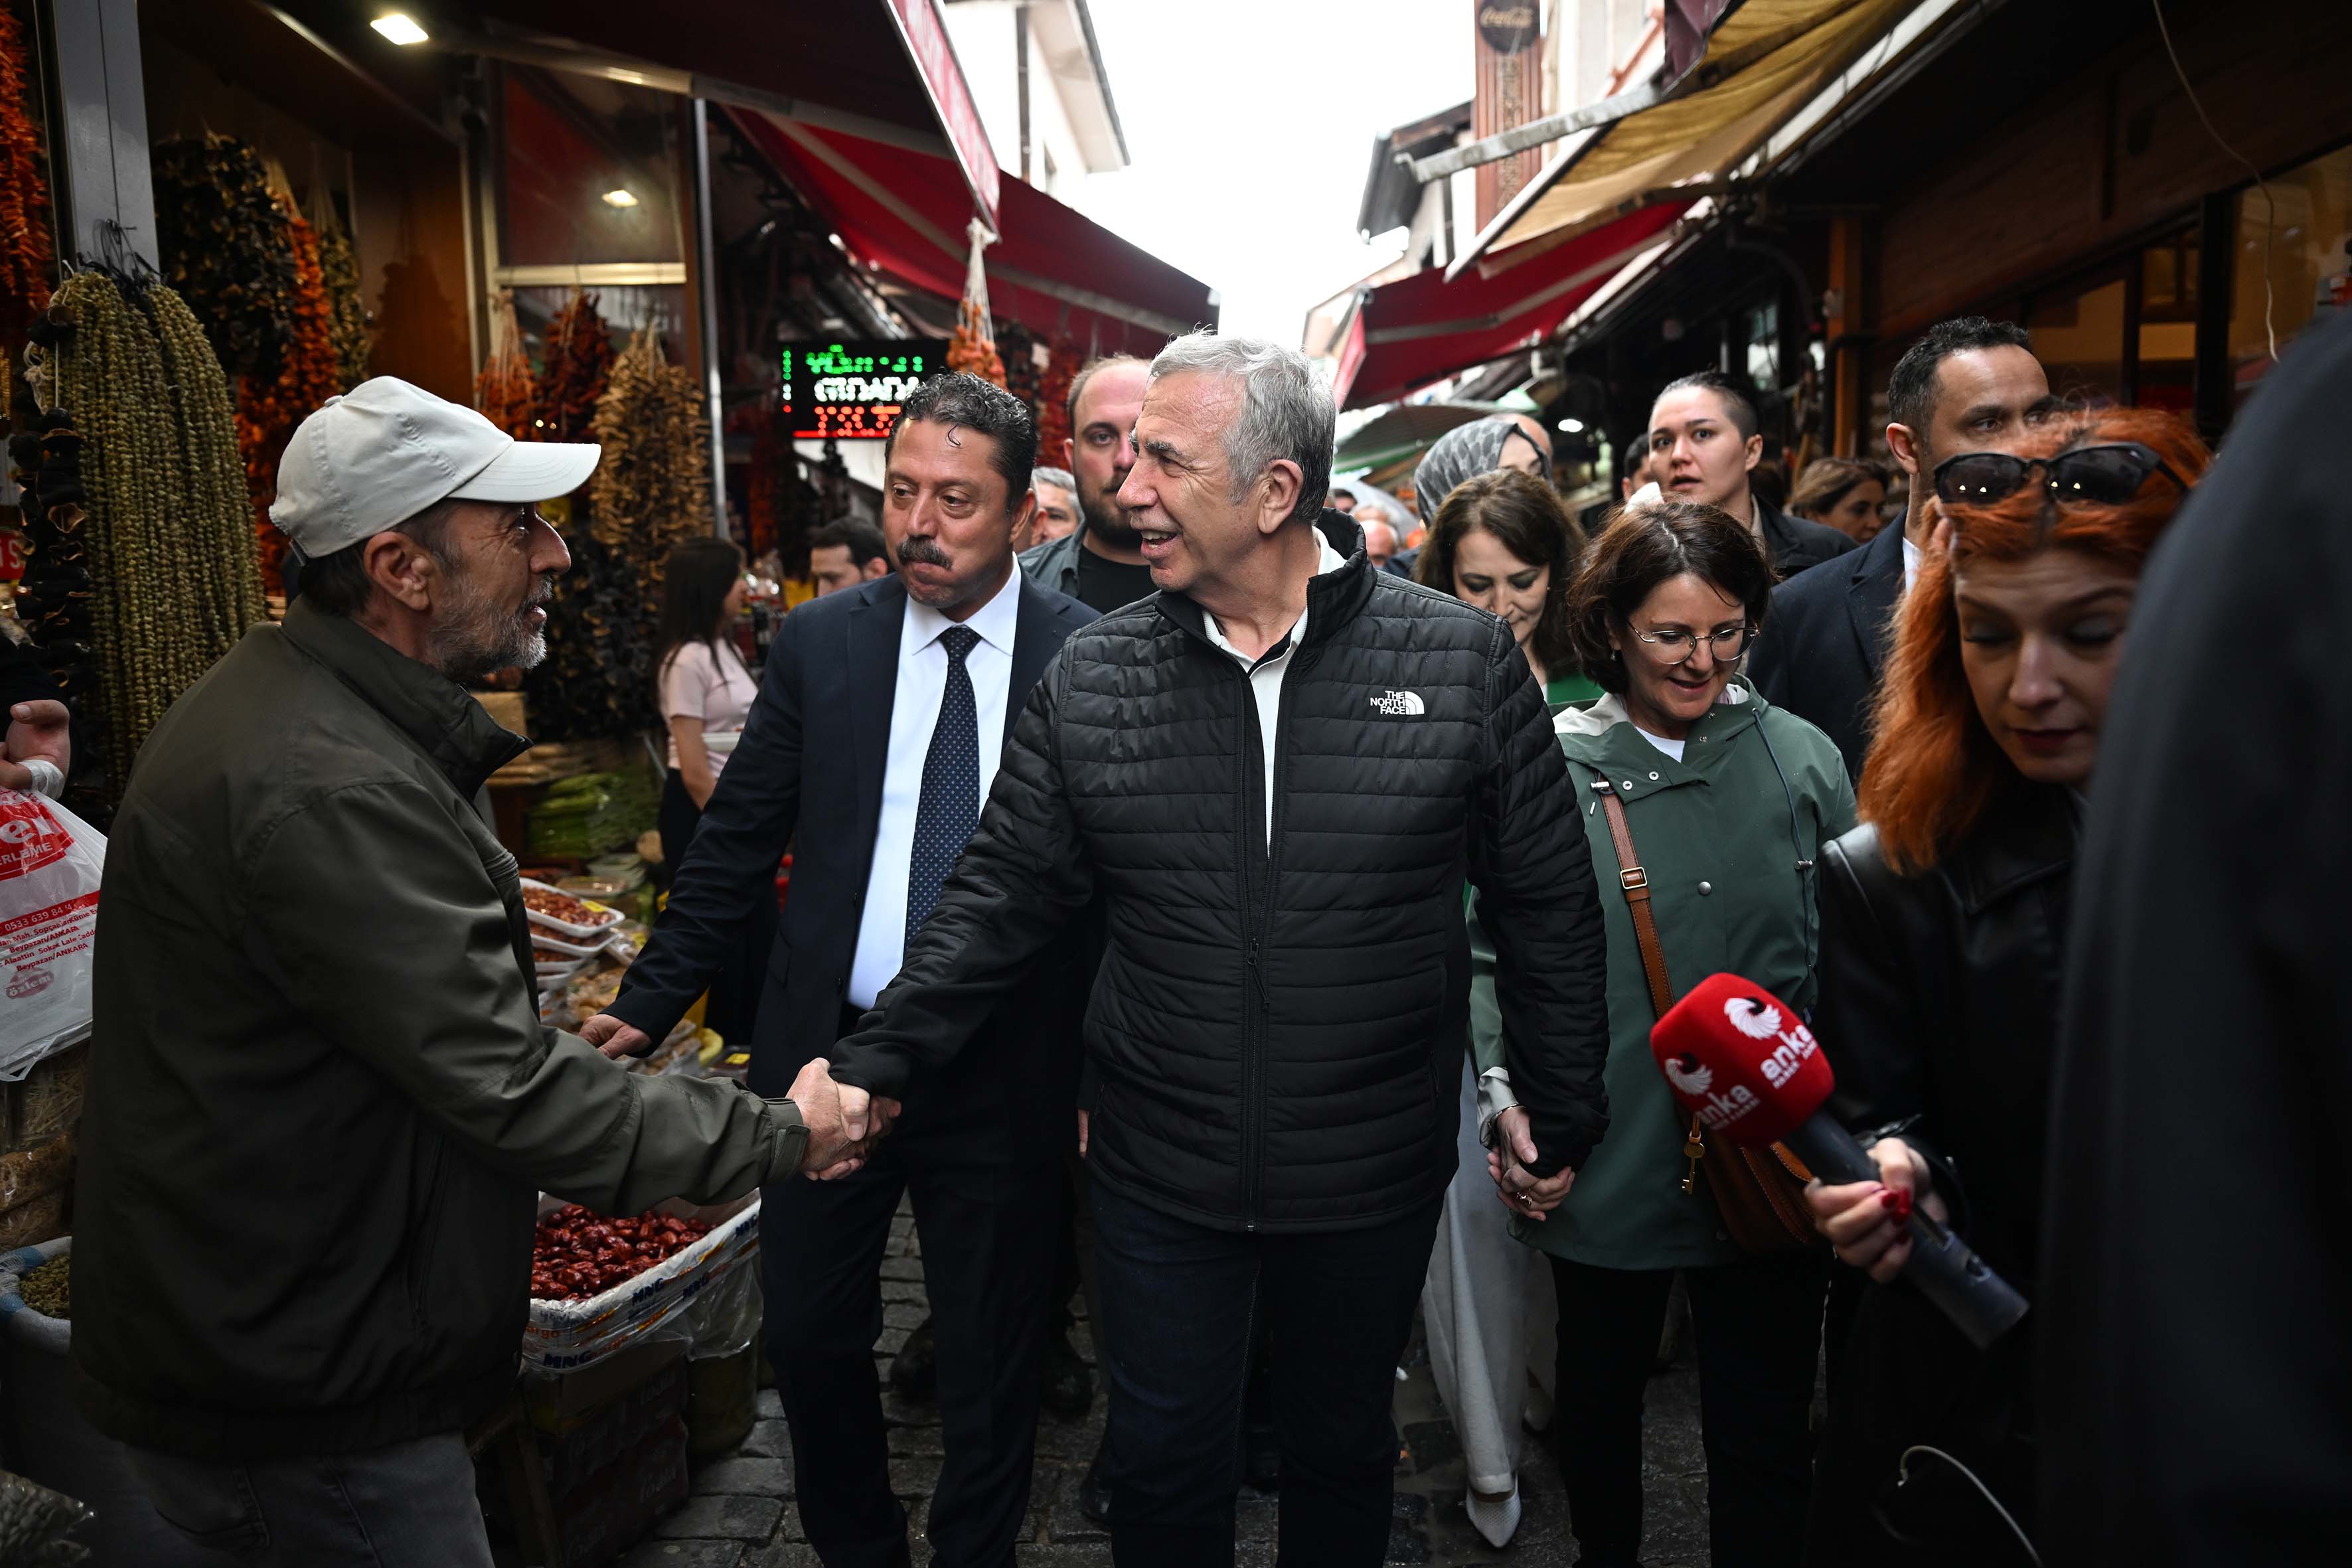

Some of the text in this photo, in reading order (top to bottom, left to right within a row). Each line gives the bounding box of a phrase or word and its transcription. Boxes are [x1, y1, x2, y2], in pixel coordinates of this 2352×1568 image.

[1370, 697, 1405, 706] NORTH
[1385, 690, 1405, 699] THE
[1380, 706, 1405, 714] FACE
[0, 842, 53, 865] RLEME
[5, 918, 29, 931] 0533
[31, 911, 49, 922] 639
[51, 905, 64, 916] 84
[5, 952, 35, 965] Alaattin
[38, 943, 60, 954] Sokak
[61, 937, 78, 946] Lale
